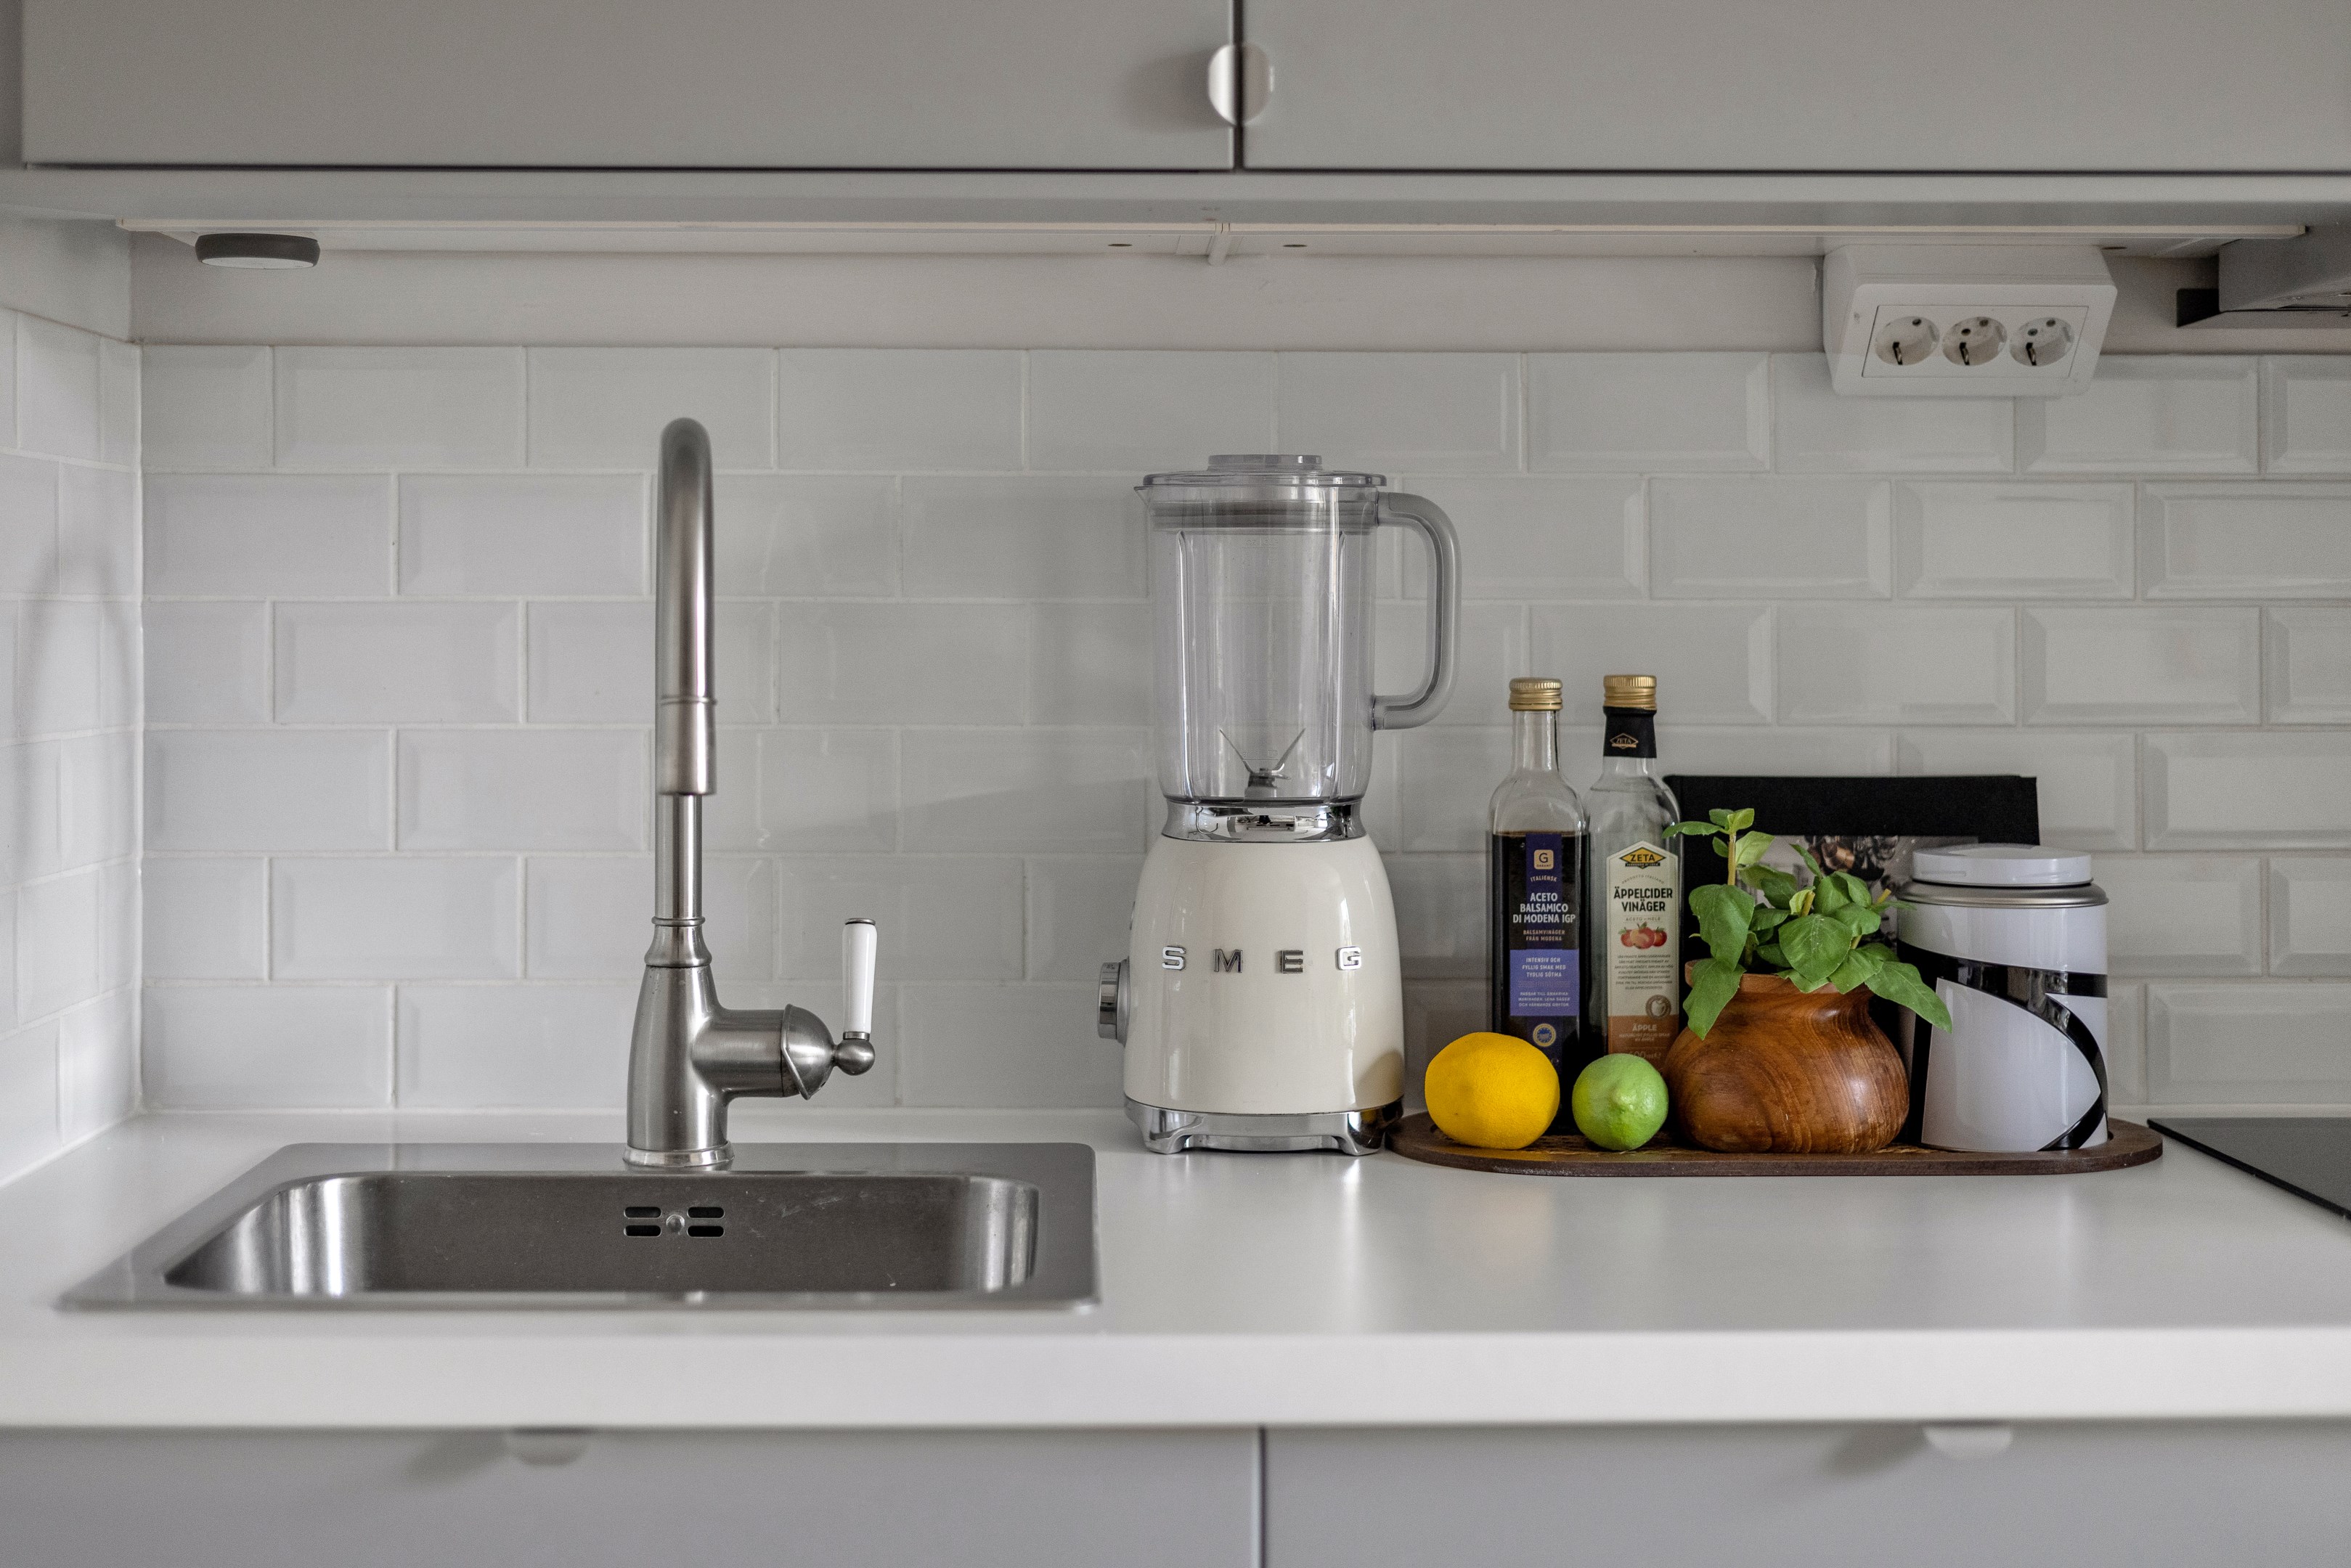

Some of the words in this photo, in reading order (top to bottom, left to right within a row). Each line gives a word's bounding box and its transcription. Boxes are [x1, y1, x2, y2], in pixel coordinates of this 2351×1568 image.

[1539, 852, 1549, 863] G
[1530, 892, 1558, 902] ACETO
[1613, 886, 1673, 899] ÄPPELCIDER
[1520, 903, 1568, 912] BALSAMICO
[1621, 899, 1666, 912] VINÄGER
[1512, 914, 1522, 923] DI
[1523, 914, 1560, 923] MODENA
[1562, 914, 1576, 923] IGP
[1162, 946, 1362, 973] SMEG
[1632, 1022, 1658, 1032] ÄPPLE
